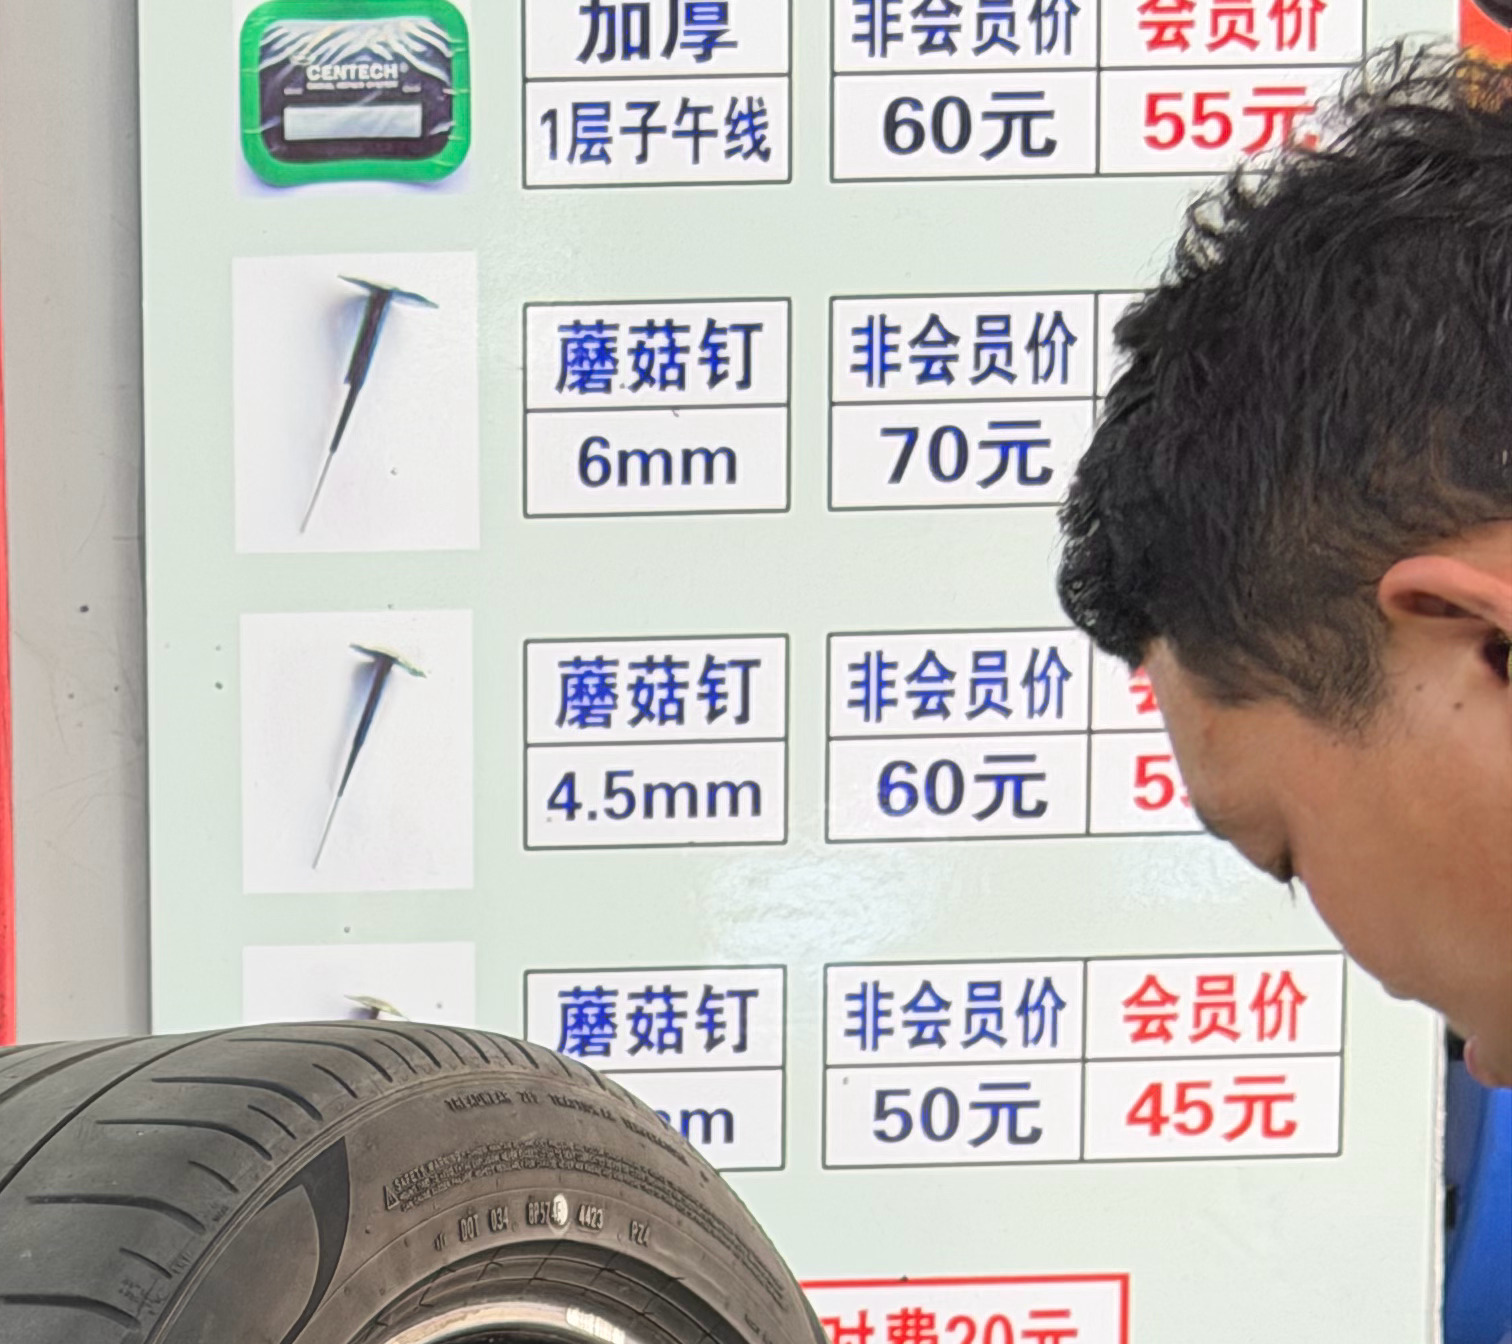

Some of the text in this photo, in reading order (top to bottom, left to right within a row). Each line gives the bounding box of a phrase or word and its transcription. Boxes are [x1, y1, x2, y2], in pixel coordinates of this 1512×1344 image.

[576, 0, 738, 64] 加厚
[851, 0, 1082, 58] 非会员价
[1138, 0, 1327, 52] 会员价
[305, 62, 399, 81] CENTECH
[540, 95, 772, 165] 1层子午线
[883, 90, 1058, 161] 60元
[555, 317, 764, 395] 蘑菇钉
[850, 310, 1078, 389] 非会员价
[578, 435, 737, 488] 6mm
[880, 419, 1054, 489] 70元
[555, 653, 762, 730] 蘑菇钉
[847, 646, 1073, 723] 非会员价
[547, 770, 762, 821] 4.5mm
[877, 753, 1048, 821] 60元
[555, 984, 759, 1057] 蘑菇钉
[844, 976, 1067, 1051] 非会员价
[1123, 971, 1307, 1043] 会员价
[873, 1081, 1043, 1148] 50元
[1125, 1075, 1297, 1141] 45元
[459, 1213, 481, 1242] DOT
[576, 1203, 604, 1230] 4423
